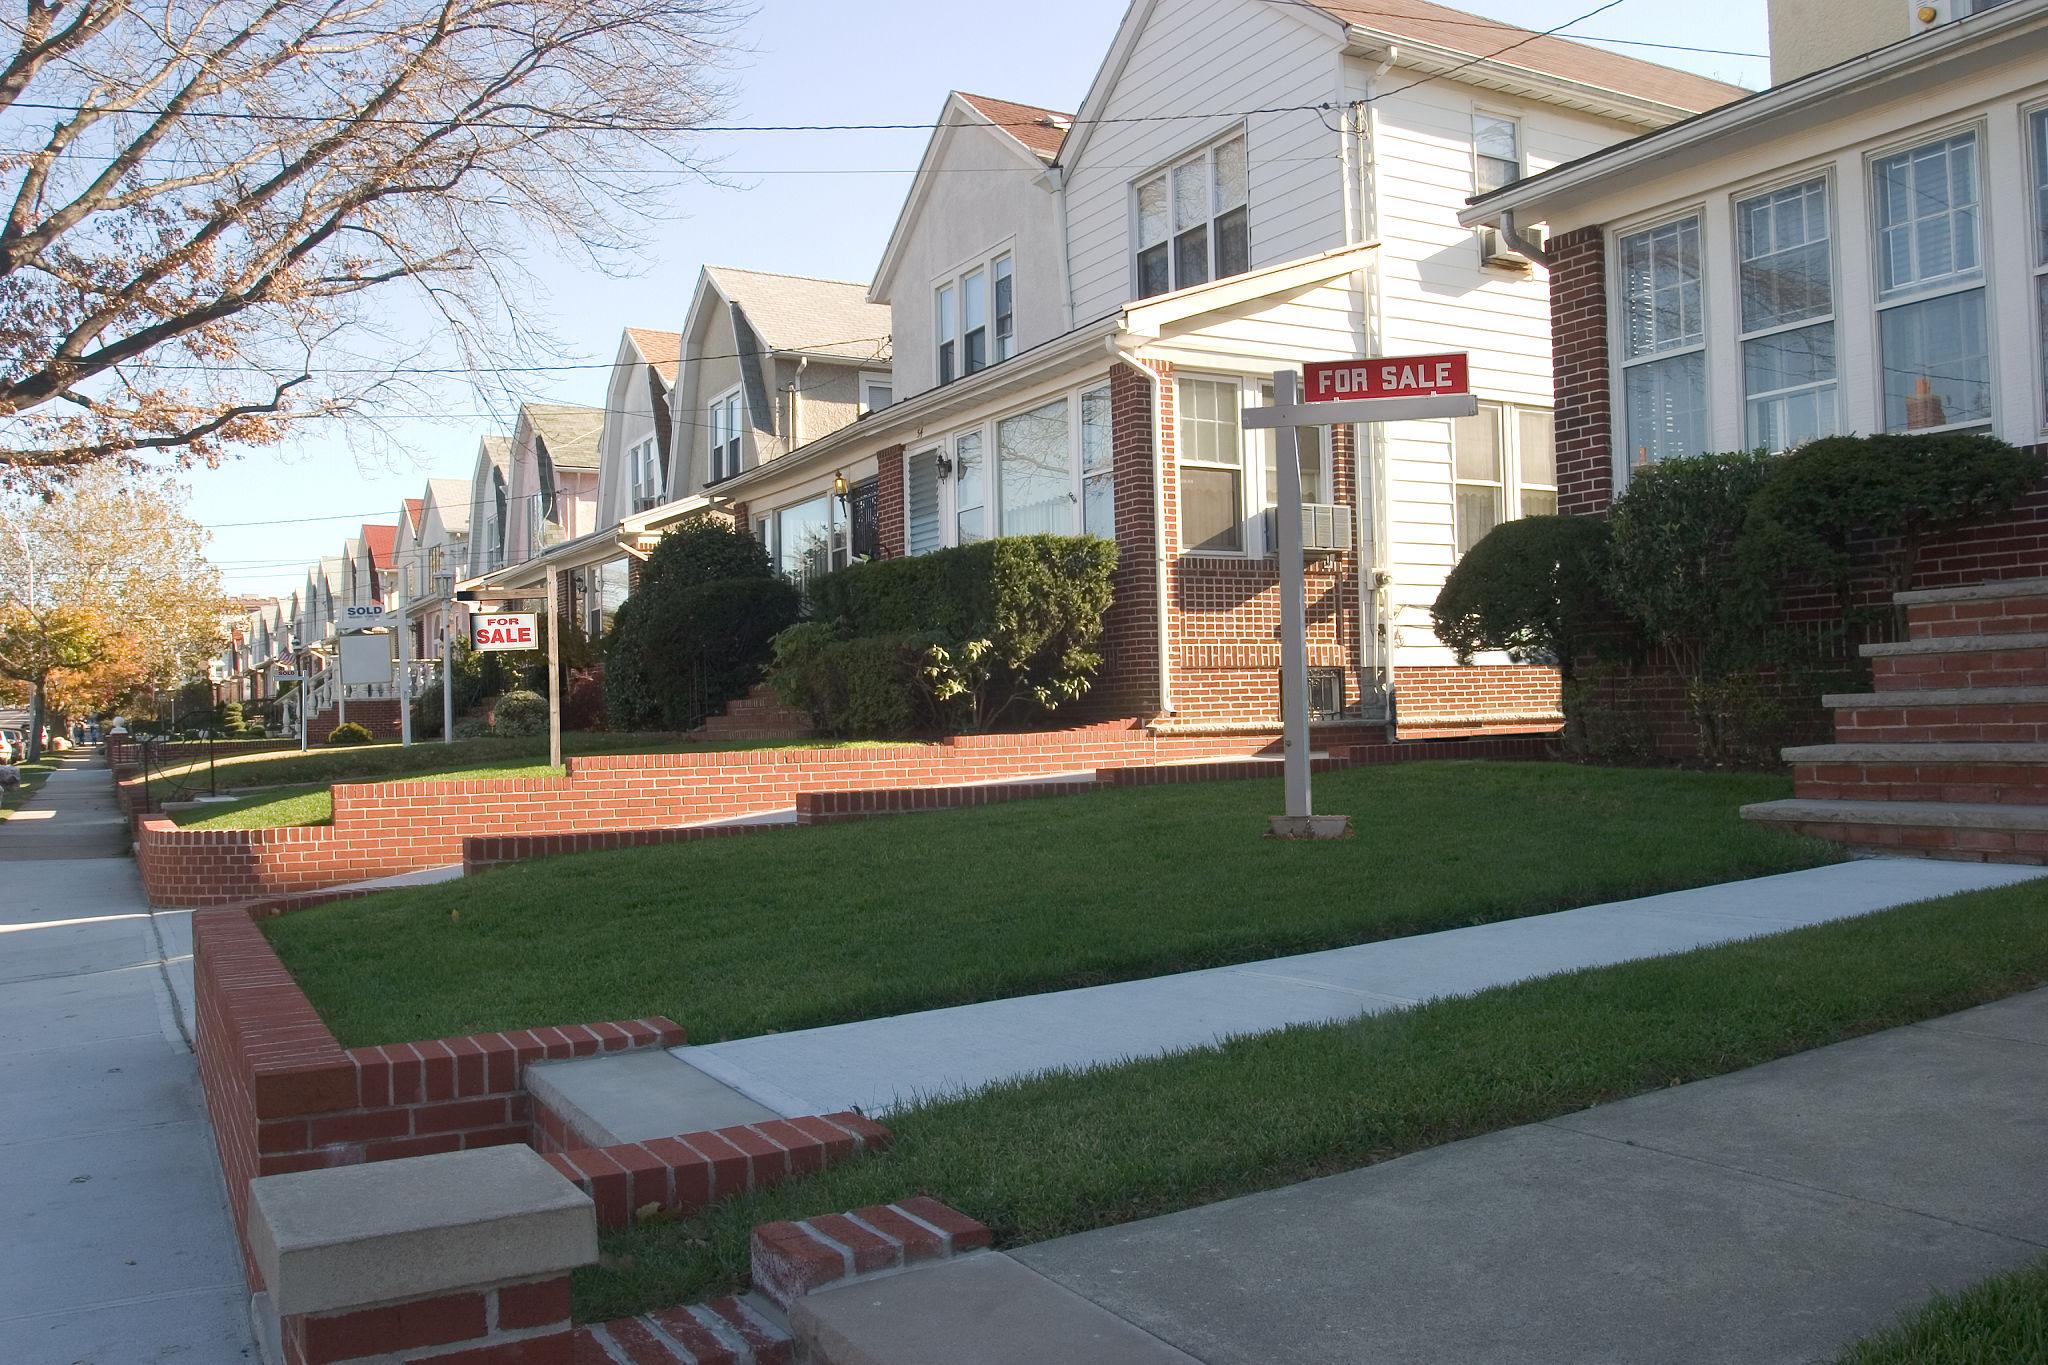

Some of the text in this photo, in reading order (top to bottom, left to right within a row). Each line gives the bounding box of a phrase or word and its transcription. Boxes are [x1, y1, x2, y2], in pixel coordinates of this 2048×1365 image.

[1318, 362, 1453, 394] FOR SALE
[347, 606, 383, 616] SOLD
[487, 617, 519, 627] FOR
[476, 627, 532, 644] SALE
